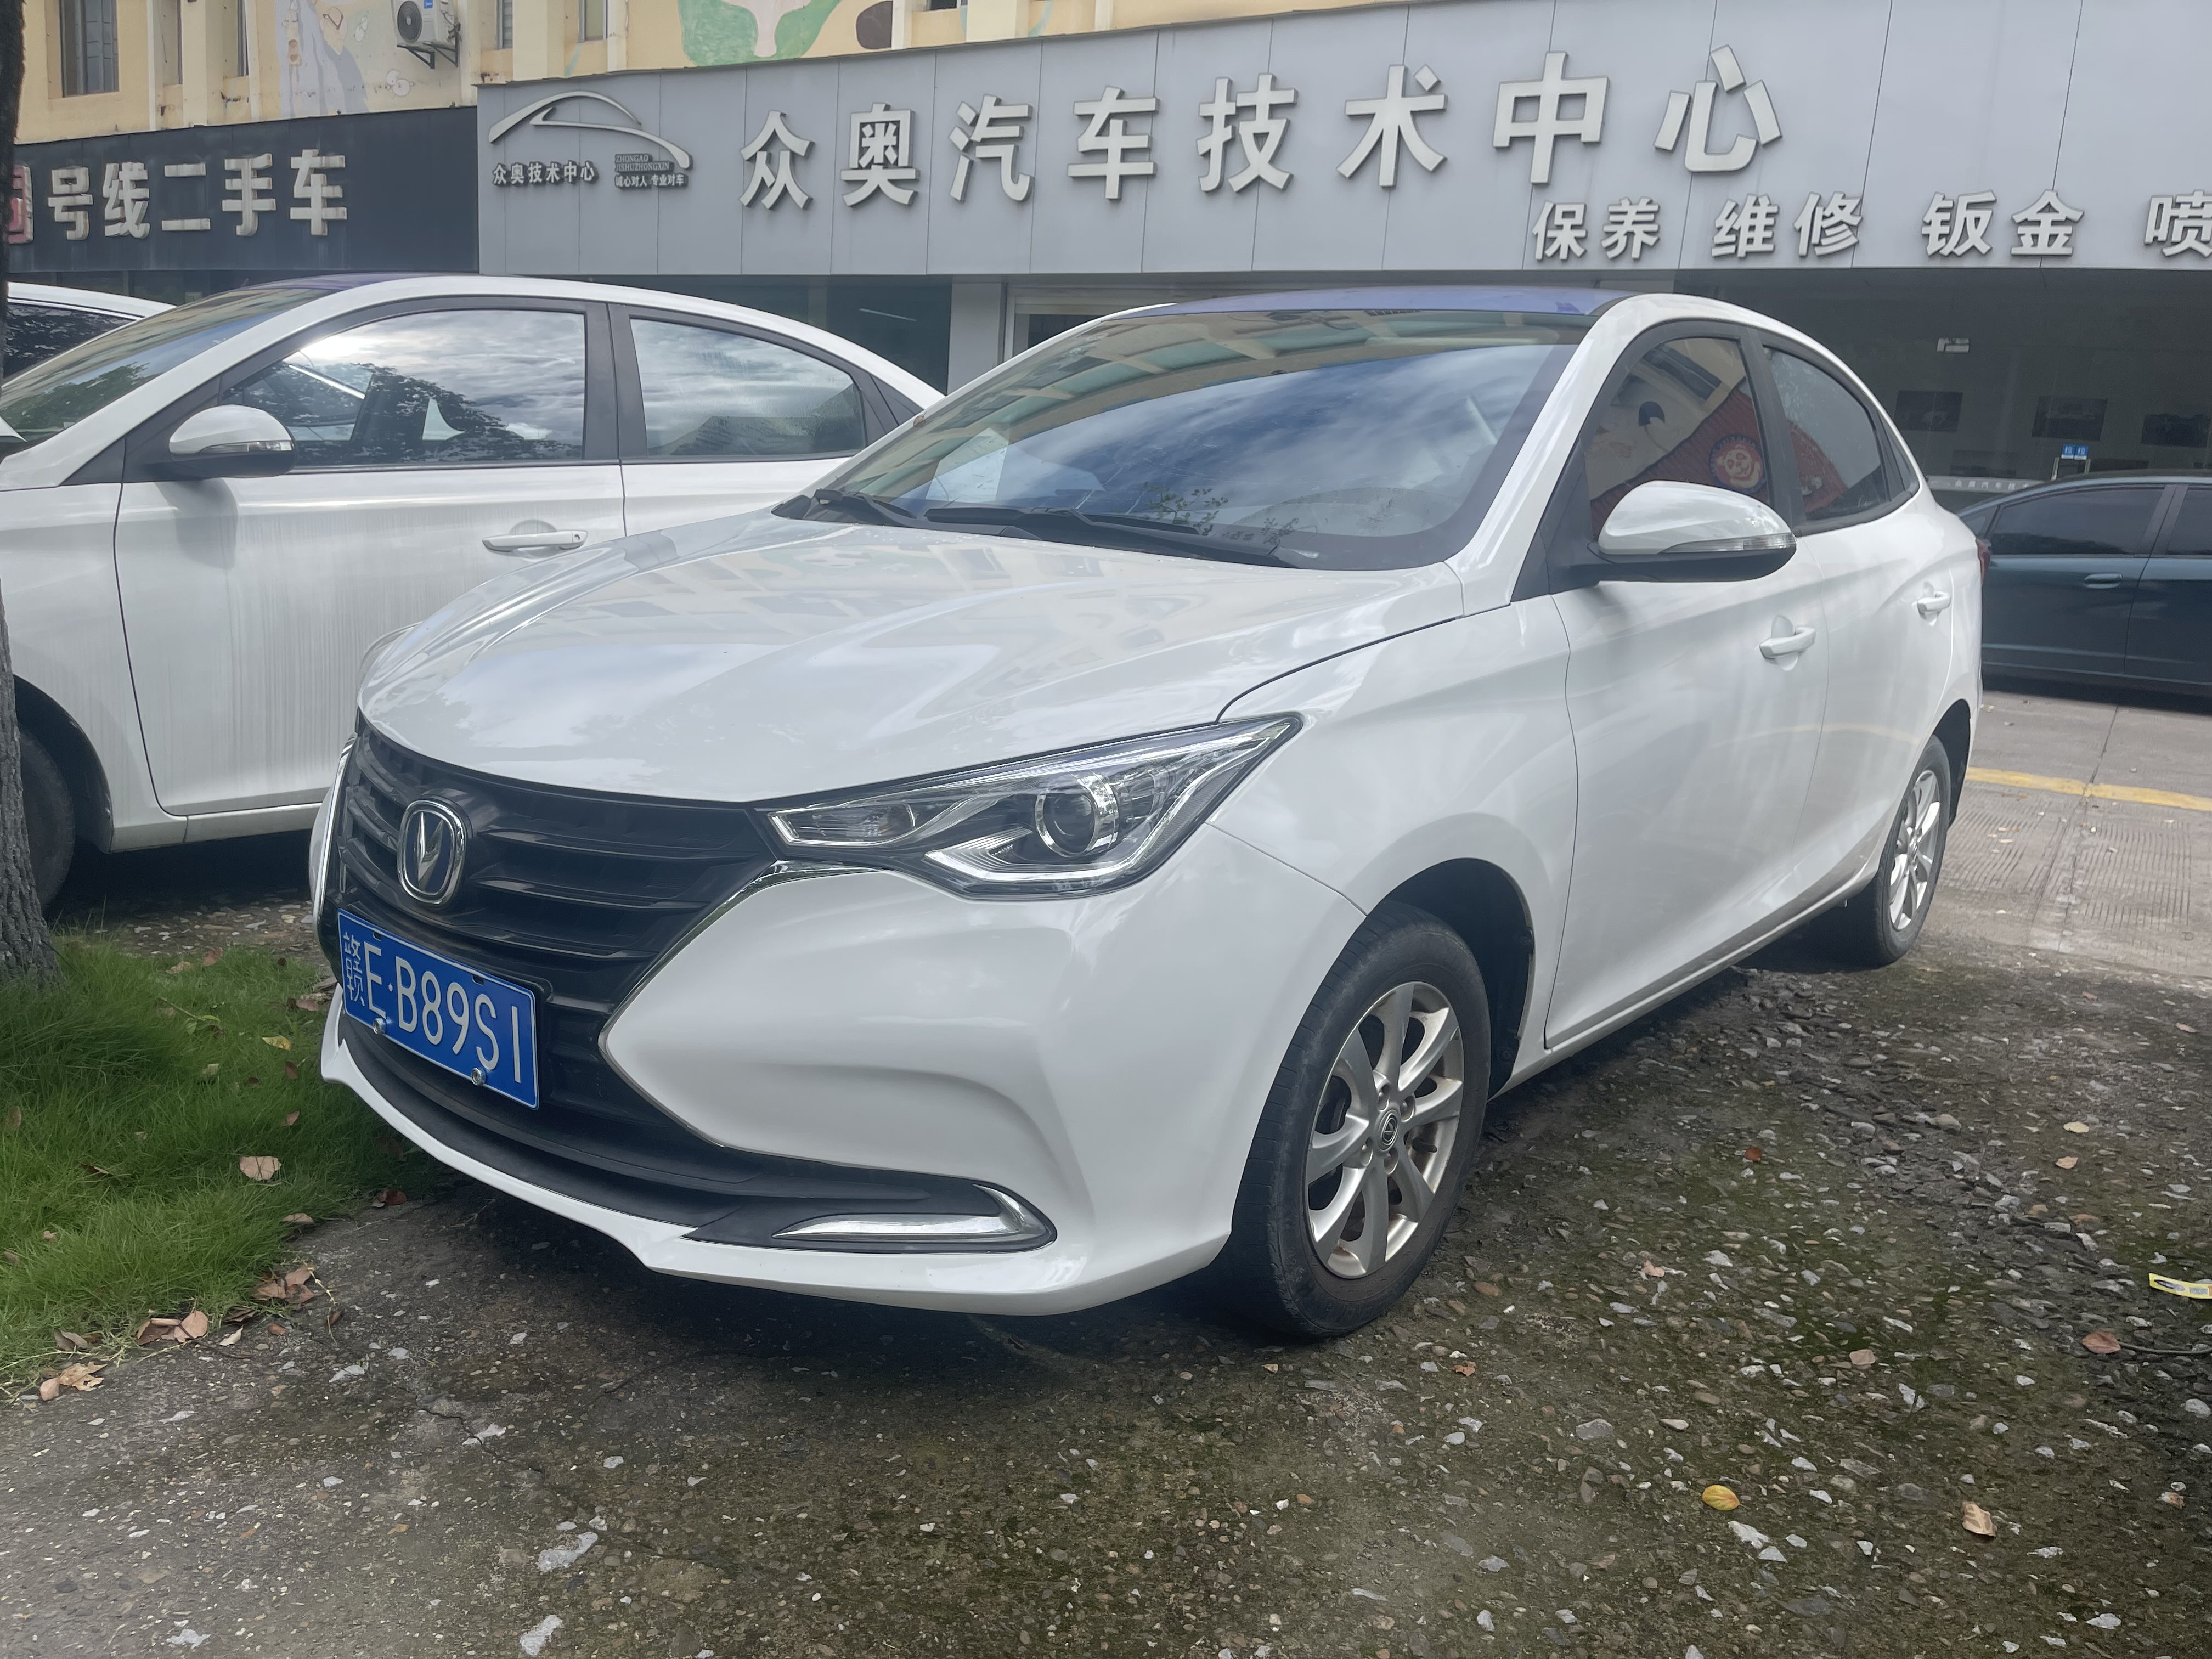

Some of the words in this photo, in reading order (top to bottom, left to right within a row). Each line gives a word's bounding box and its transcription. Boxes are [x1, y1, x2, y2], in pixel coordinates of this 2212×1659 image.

[738, 44, 1784, 212] 众奥汽车技术中心
[492, 161, 597, 185] 众奥技术中心
[1532, 197, 1661, 261] 保养
[1710, 190, 1864, 258] 维修
[1921, 189, 2085, 257] 钣金
[2143, 189, 2212, 257] 喷
